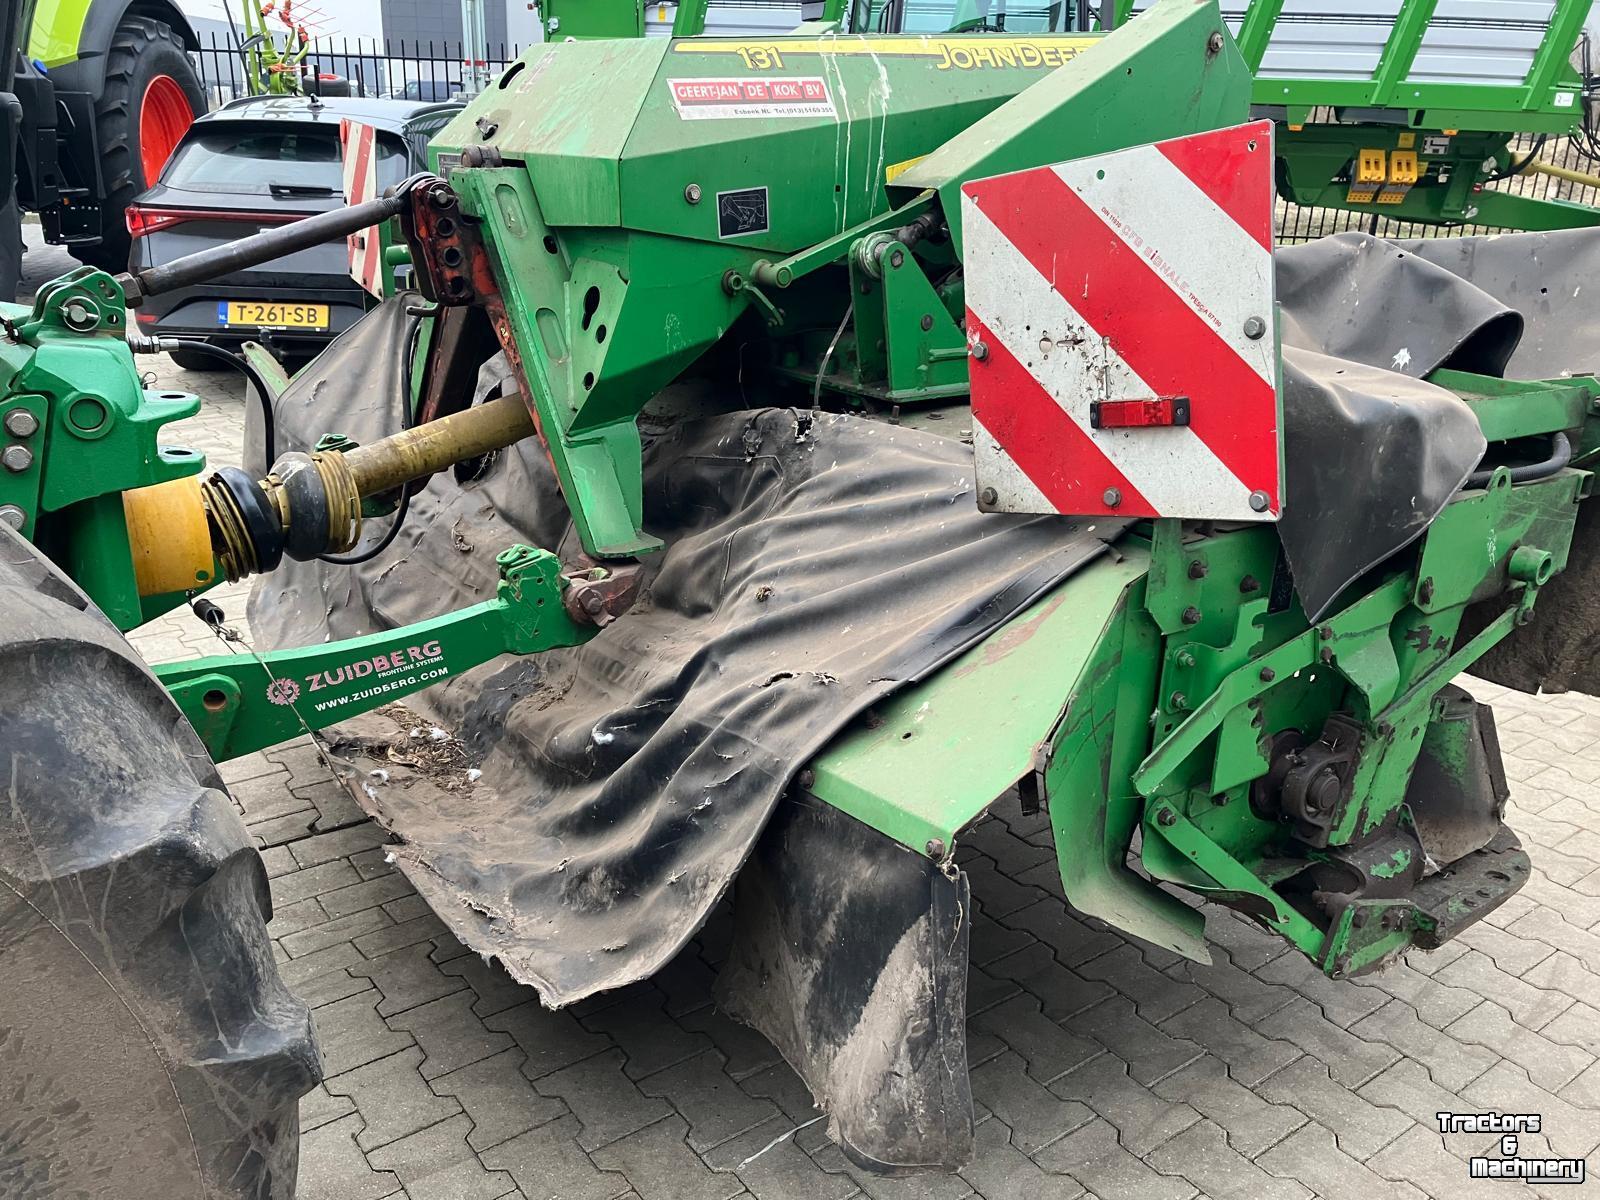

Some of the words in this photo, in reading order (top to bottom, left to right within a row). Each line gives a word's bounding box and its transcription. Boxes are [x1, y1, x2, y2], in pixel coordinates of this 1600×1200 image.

[737, 46, 784, 69] 131
[937, 43, 1017, 70] JOHN
[677, 84, 739, 99] GEERT-JAN
[747, 84, 765, 97] DE
[774, 84, 800, 97] KOK
[806, 84, 821, 96] BV
[236, 304, 318, 323] T-261-SB
[305, 640, 442, 692] ZUIDBERG
[377, 663, 415, 678] FRONTLINE
[415, 655, 444, 668] SYSTEMS
[315, 667, 449, 712] WWW.ZUIDBERG.COM
